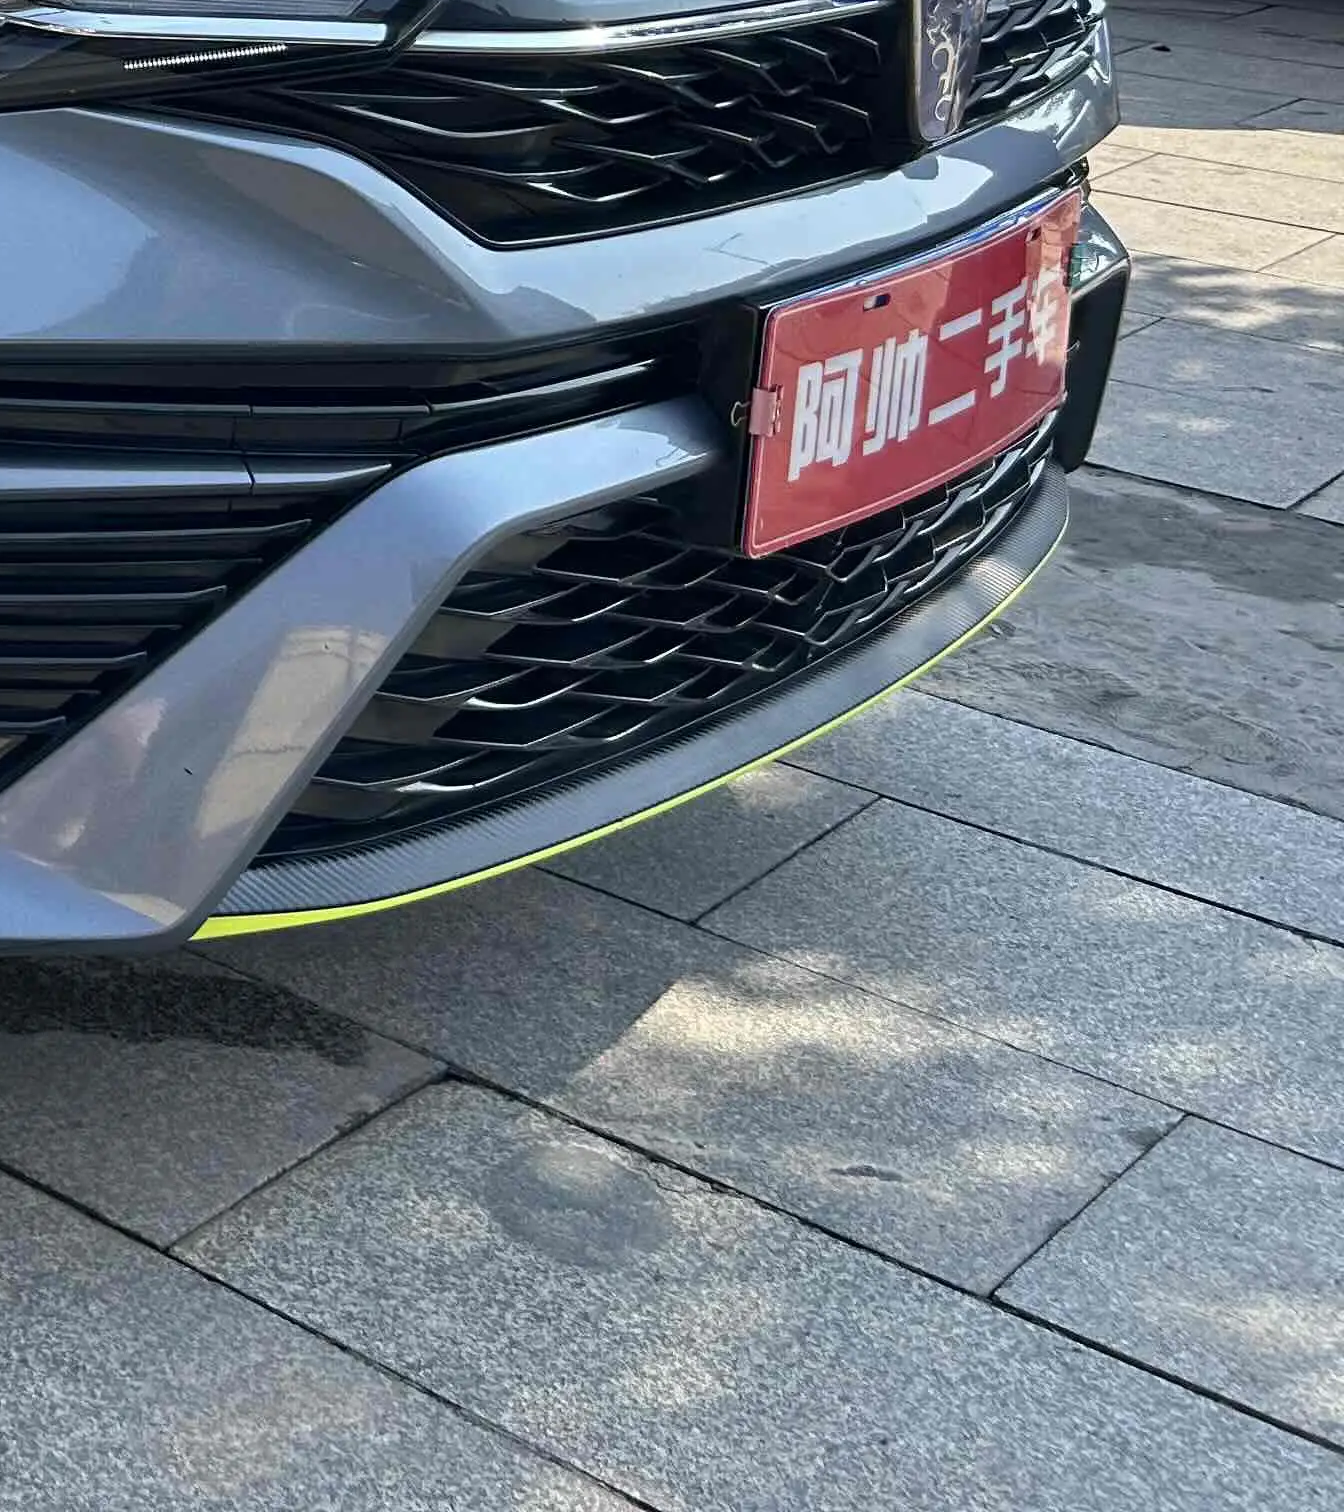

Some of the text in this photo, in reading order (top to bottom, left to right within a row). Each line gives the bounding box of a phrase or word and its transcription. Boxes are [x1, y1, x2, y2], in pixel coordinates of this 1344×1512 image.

[787, 270, 1061, 482] 阿帅二手车
